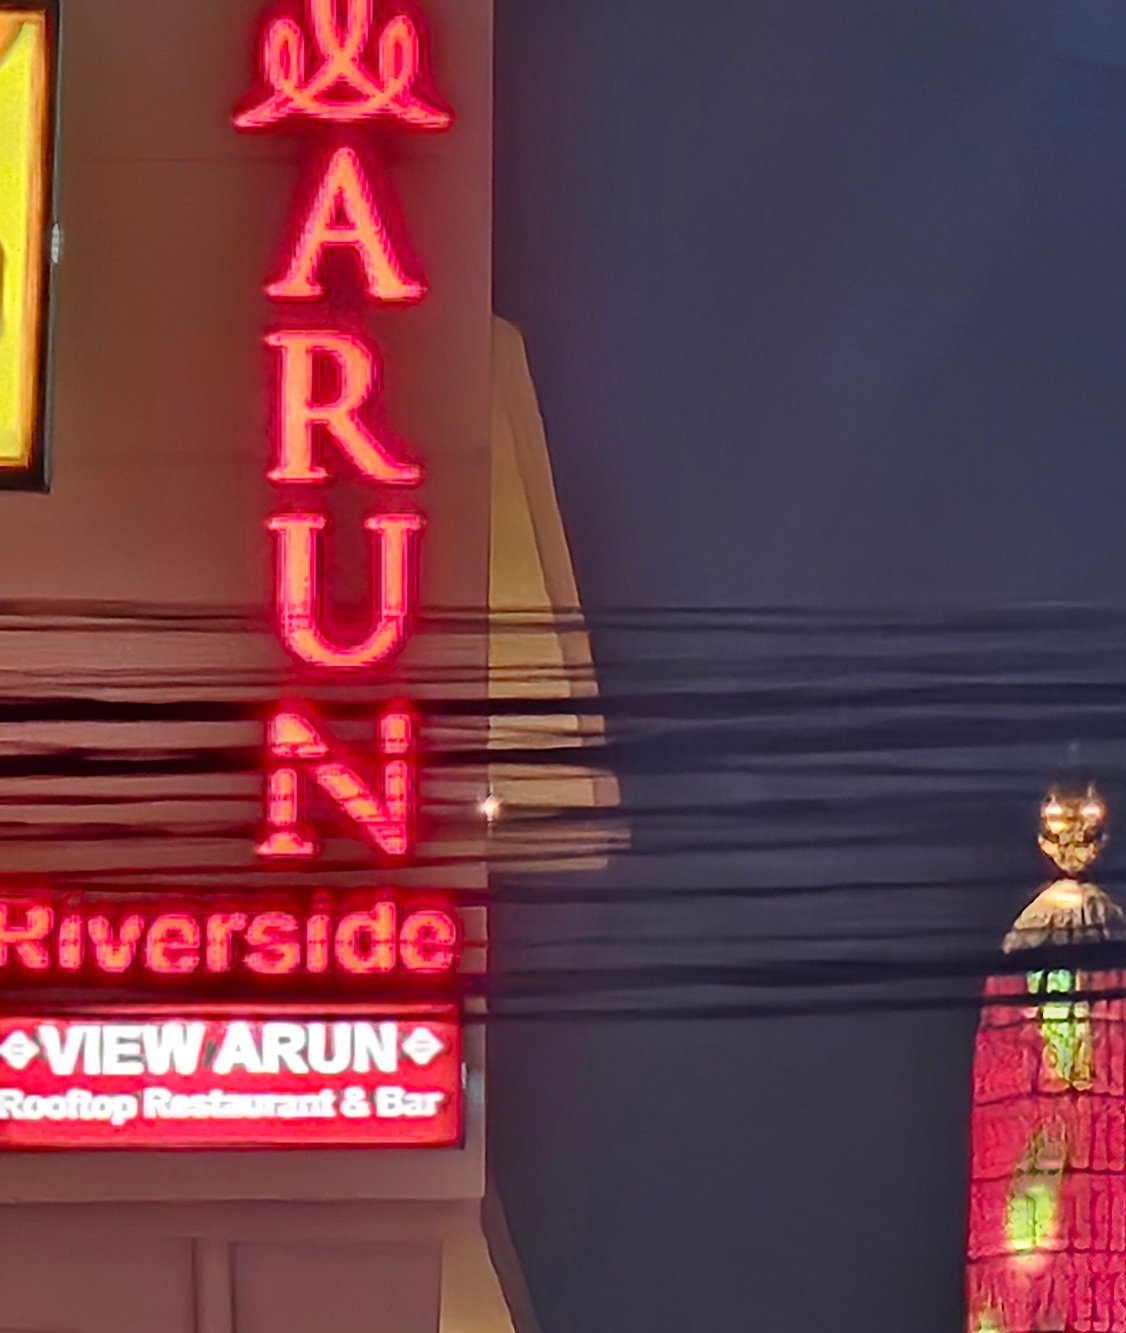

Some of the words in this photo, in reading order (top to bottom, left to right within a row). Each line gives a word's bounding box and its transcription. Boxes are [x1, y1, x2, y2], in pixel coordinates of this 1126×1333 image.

[255, 145, 428, 857] ARUN
[0, 893, 458, 974] Riverside
[38, 1022, 205, 1076] VIEW
[211, 1021, 399, 1075] ARUN
[0, 1088, 138, 1125] Rooftop
[143, 1087, 335, 1119] Restaurant
[340, 1086, 370, 1118] &
[375, 1086, 444, 1118] Bar
